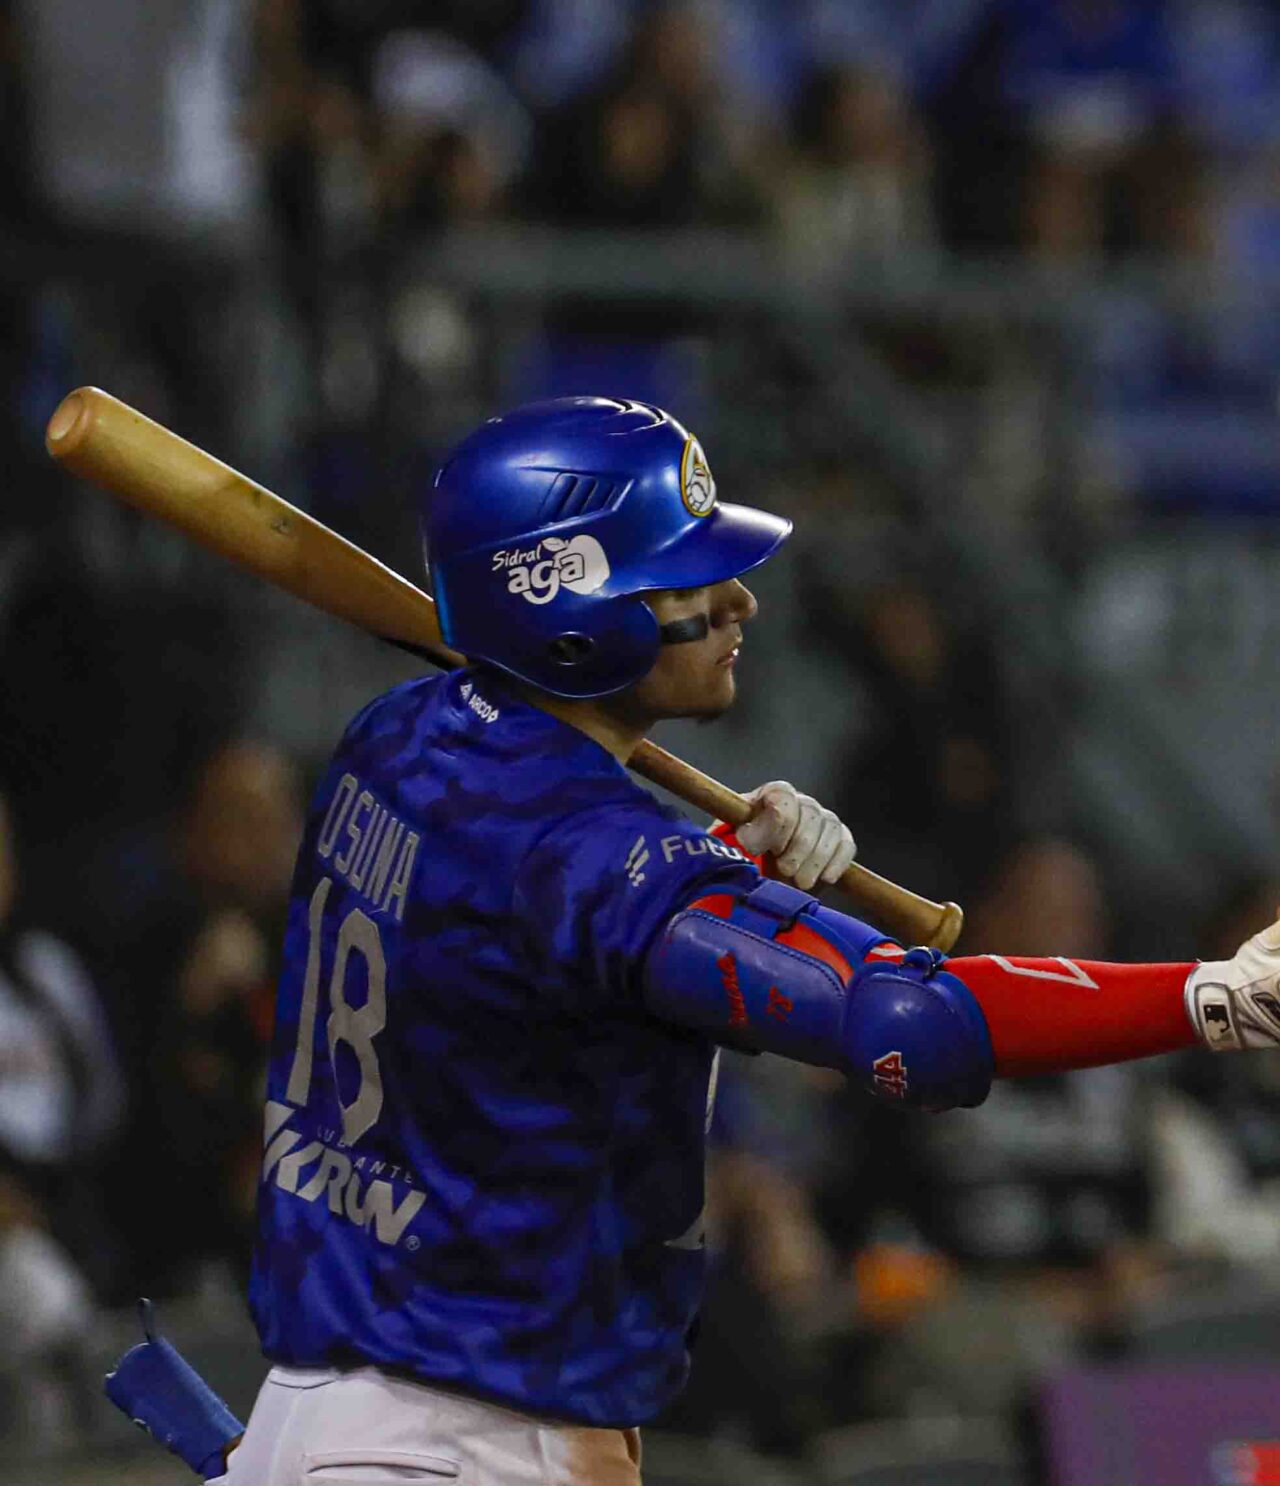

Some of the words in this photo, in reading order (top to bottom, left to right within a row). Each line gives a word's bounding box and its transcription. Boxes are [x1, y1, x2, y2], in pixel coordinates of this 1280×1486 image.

[491, 543, 542, 571] Sidral
[507, 552, 585, 605] aga
[317, 773, 420, 922] OSUNA
[285, 876, 387, 1147] 18
